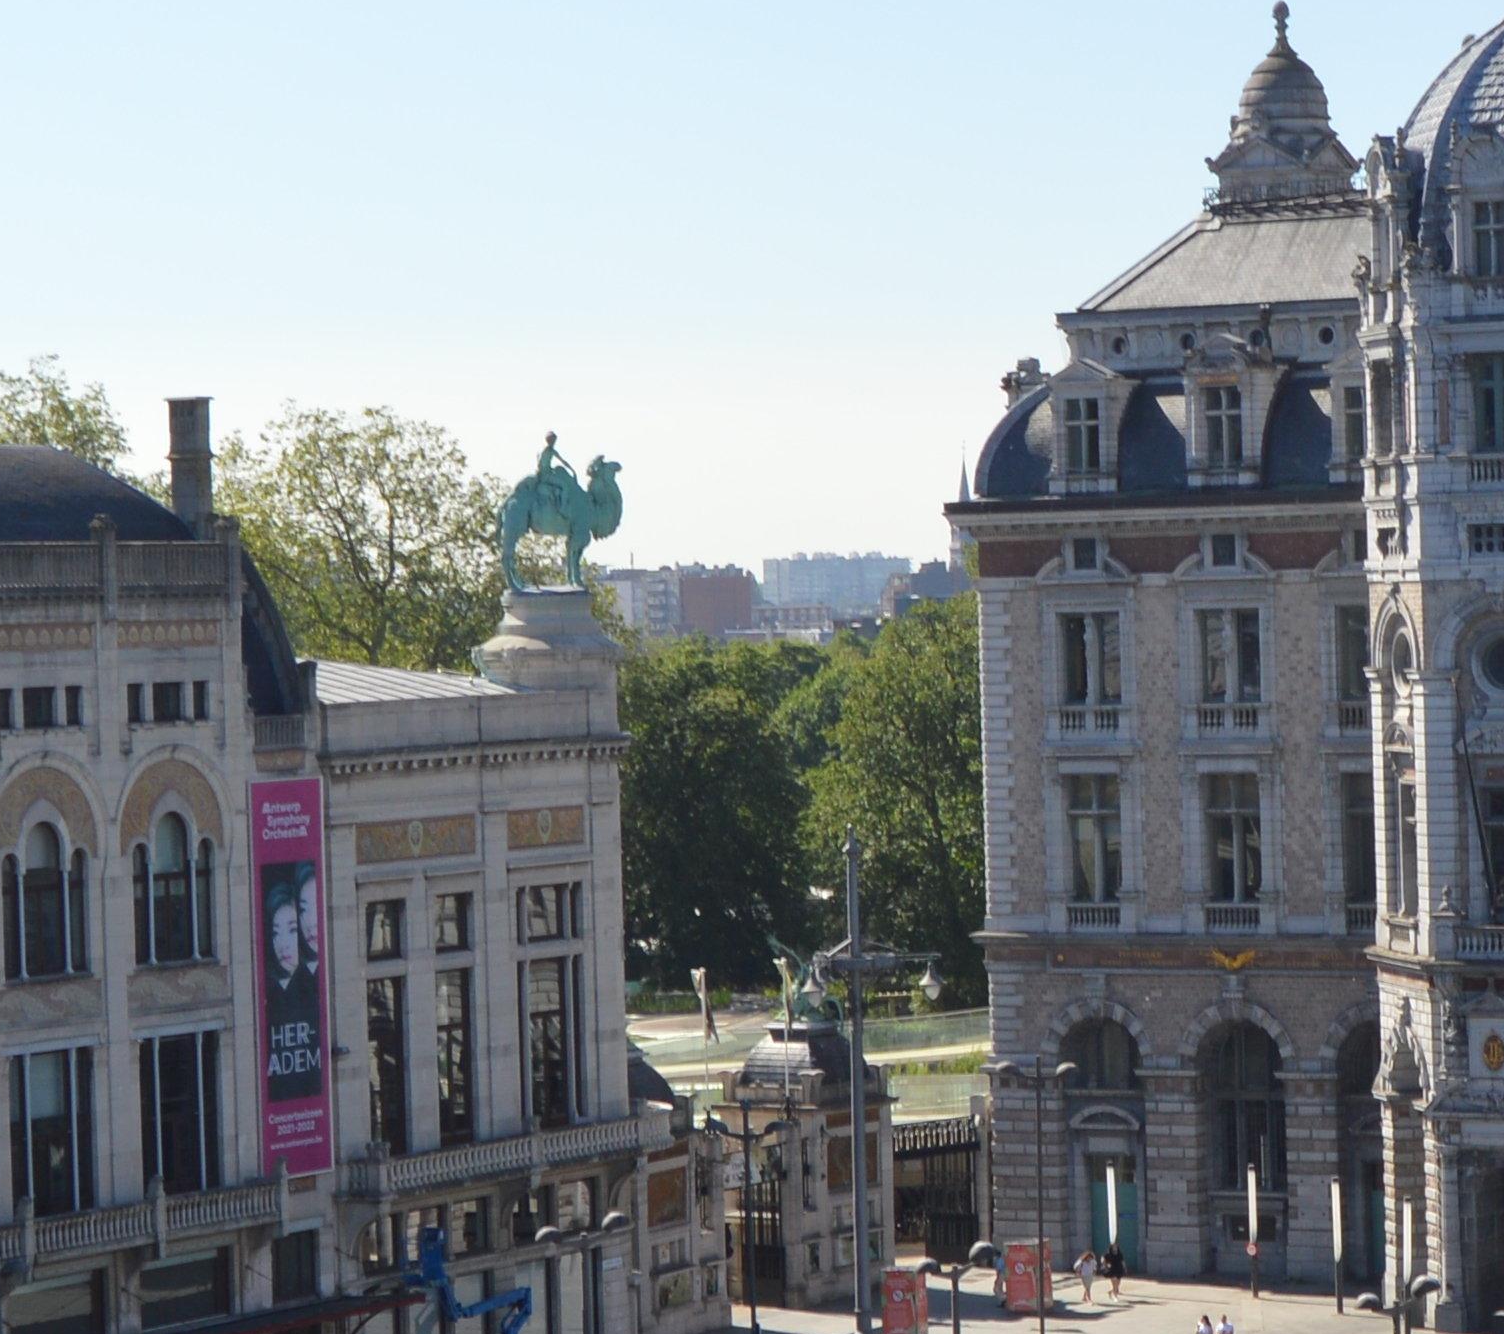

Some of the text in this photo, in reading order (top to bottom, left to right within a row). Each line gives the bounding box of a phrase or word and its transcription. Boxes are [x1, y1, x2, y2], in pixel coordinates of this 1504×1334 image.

[262, 802, 301, 814] Antwerp
[267, 814, 311, 829] Symphony
[271, 1022, 316, 1047] HER-
[267, 1047, 321, 1076] ADEM
